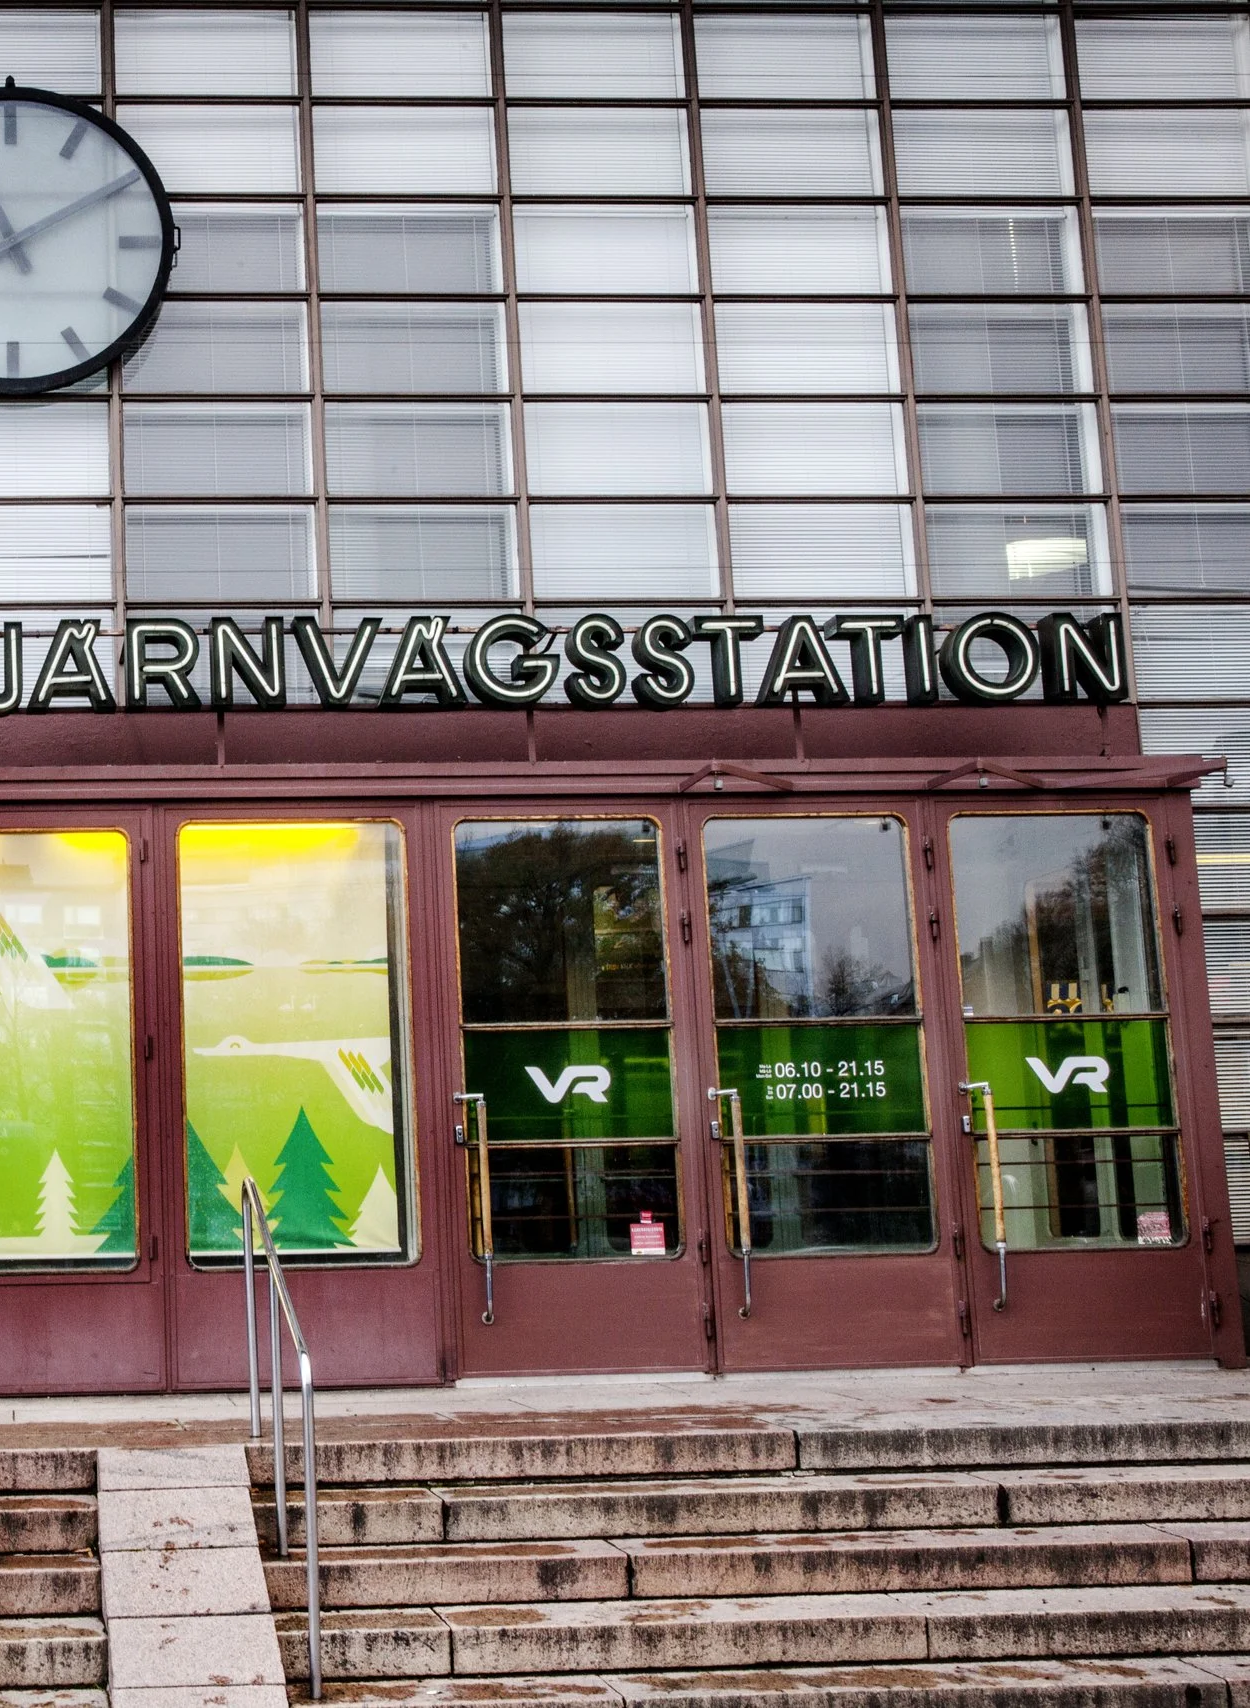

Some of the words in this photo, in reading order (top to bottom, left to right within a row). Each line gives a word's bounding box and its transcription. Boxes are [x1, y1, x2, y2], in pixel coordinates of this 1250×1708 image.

[774, 1061, 822, 1078] 06.10
[837, 1060, 885, 1077] 21.15
[1025, 1056, 1111, 1094] VR
[524, 1065, 611, 1104] VR
[776, 1083, 823, 1100] 07.00
[839, 1081, 887, 1098] 21.15
